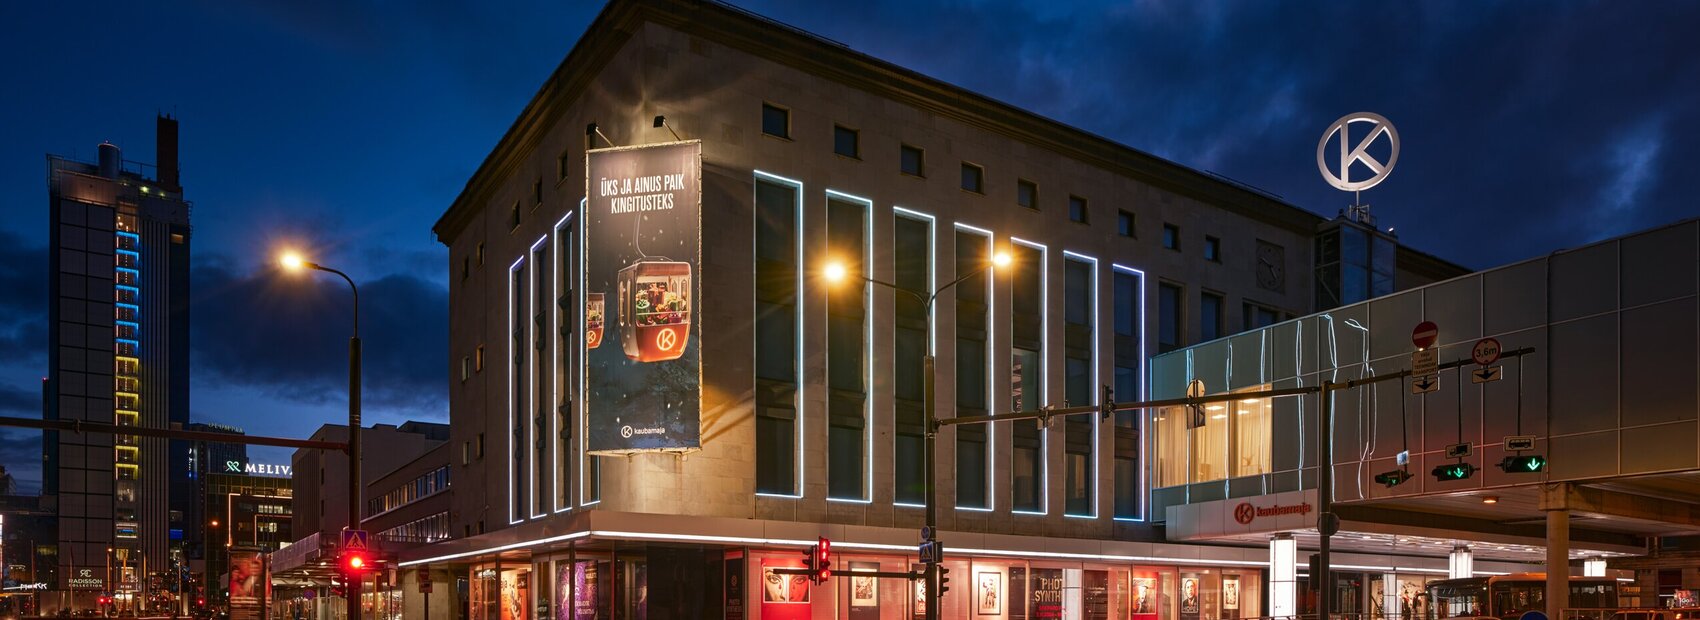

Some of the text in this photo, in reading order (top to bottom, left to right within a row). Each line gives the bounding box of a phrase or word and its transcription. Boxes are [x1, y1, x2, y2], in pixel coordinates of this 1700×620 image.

[601, 173, 685, 197] ÜKS JA AINUS PAIK
[611, 193, 674, 214] KINGITUSTEKS
[1476, 347, 1497, 358] 3,6m
[634, 427, 666, 436] kaubamaja
[1256, 502, 1312, 517] kaubamaja
[1035, 590, 1063, 603] SYNTH
